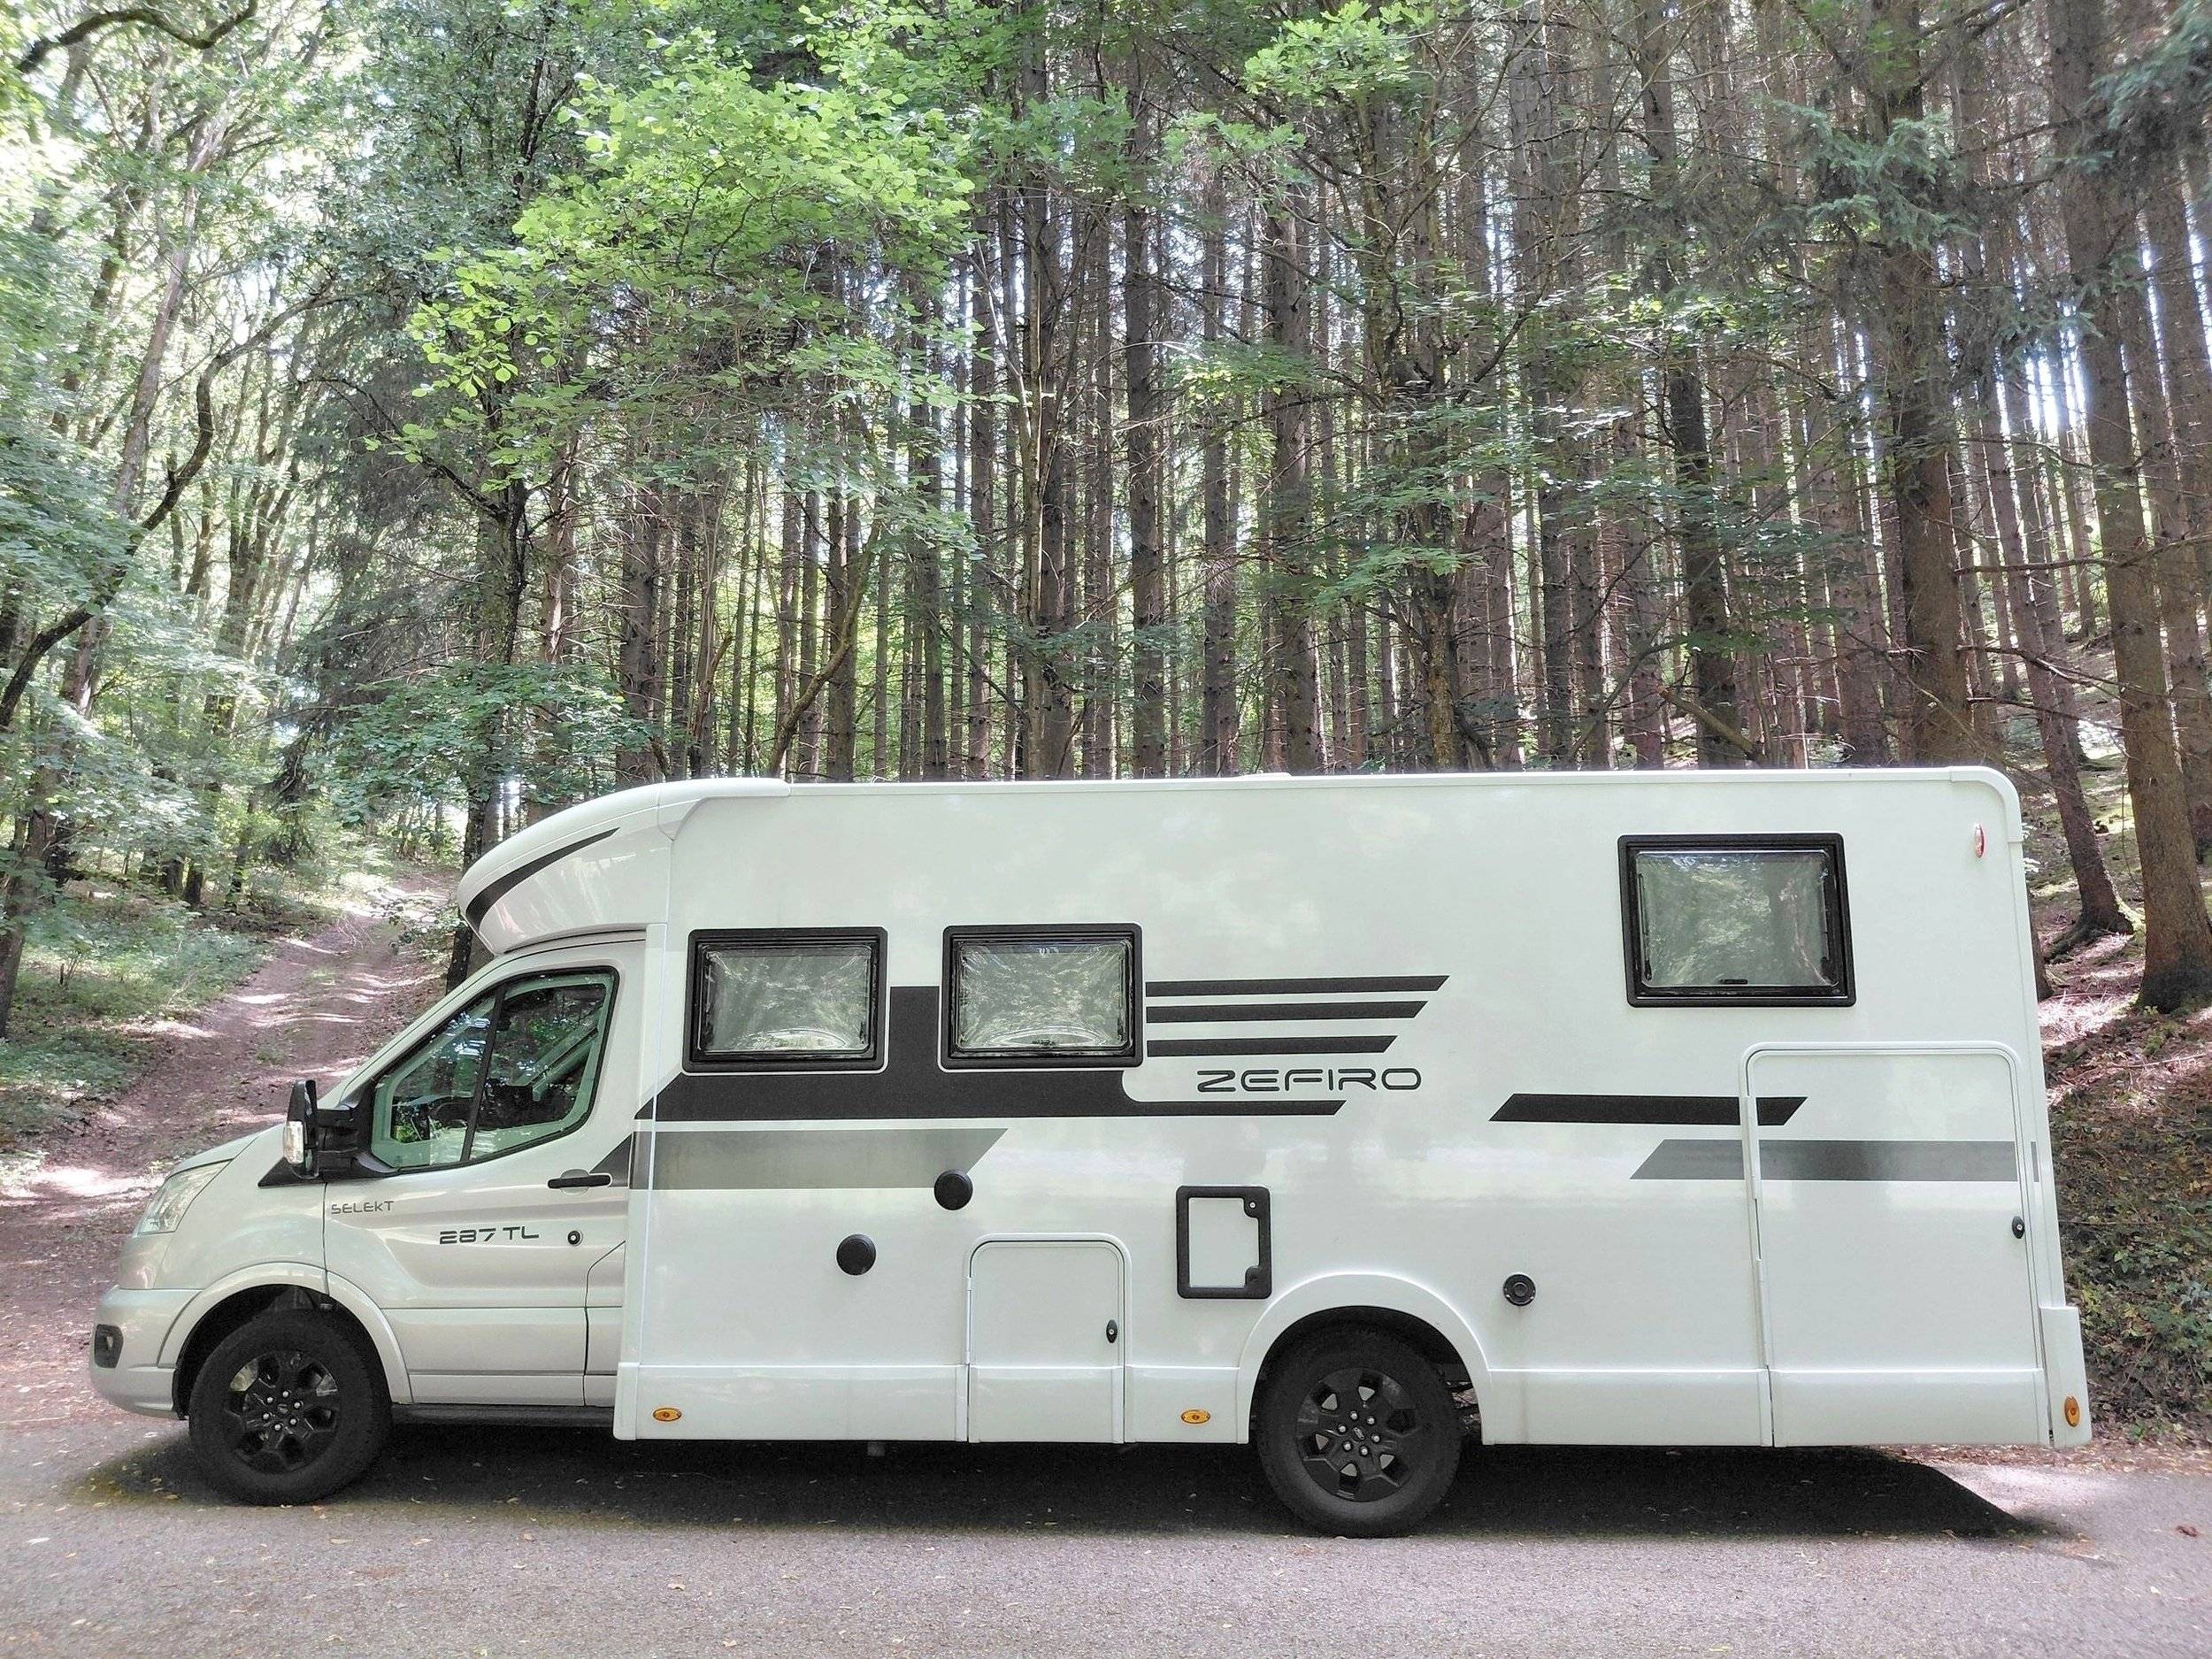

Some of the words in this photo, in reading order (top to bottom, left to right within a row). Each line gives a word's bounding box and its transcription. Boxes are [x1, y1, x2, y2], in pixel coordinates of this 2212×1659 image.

[1196, 1068, 1422, 1093] ZEFIRO
[439, 1227, 496, 1245] 287
[503, 1225, 540, 1240] TL
